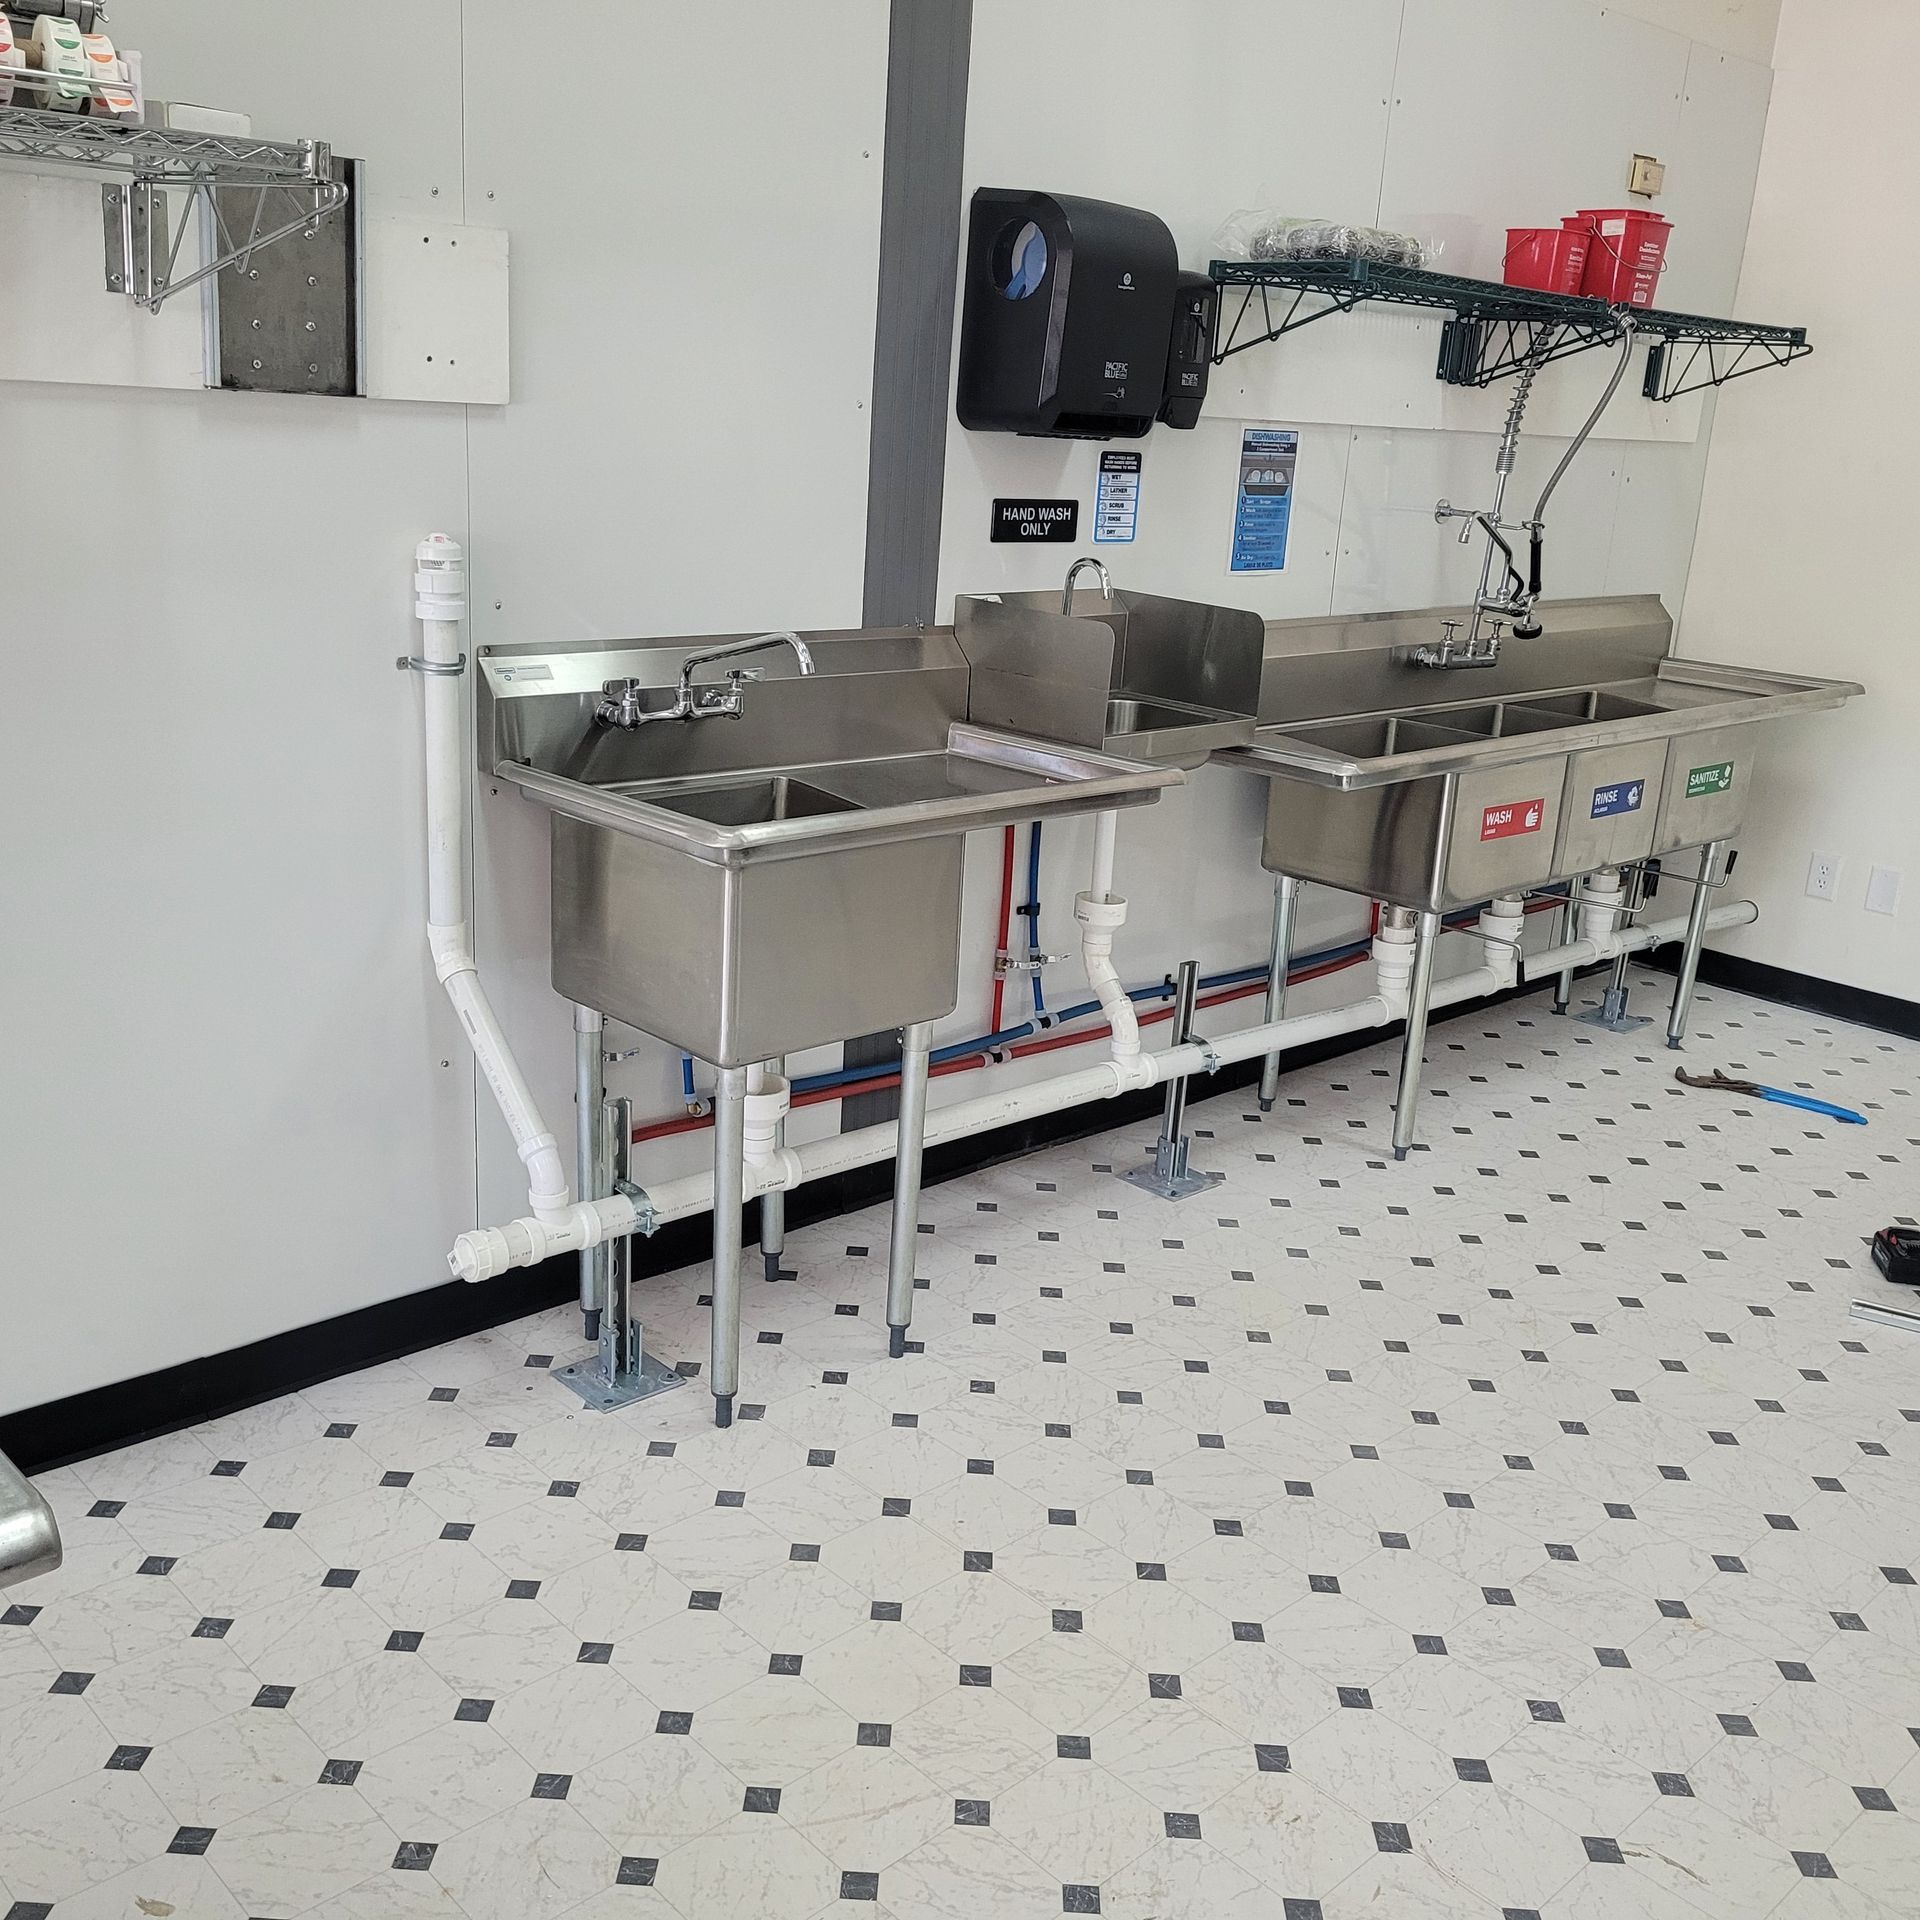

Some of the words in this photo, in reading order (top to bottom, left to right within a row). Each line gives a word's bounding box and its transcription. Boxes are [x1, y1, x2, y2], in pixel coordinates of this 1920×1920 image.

[1105, 361, 1128, 371] PACIFIC
[1105, 370, 1119, 379] BLUE
[1252, 432, 1290, 441] DISHWASHING
[1003, 508, 1035, 520] HAND
[1038, 508, 1071, 520] WASH
[1020, 523, 1051, 536] ONLY
[1690, 770, 1720, 786] SANITIZE
[1595, 790, 1618, 806] RINSE
[1486, 809, 1512, 826] WASH
